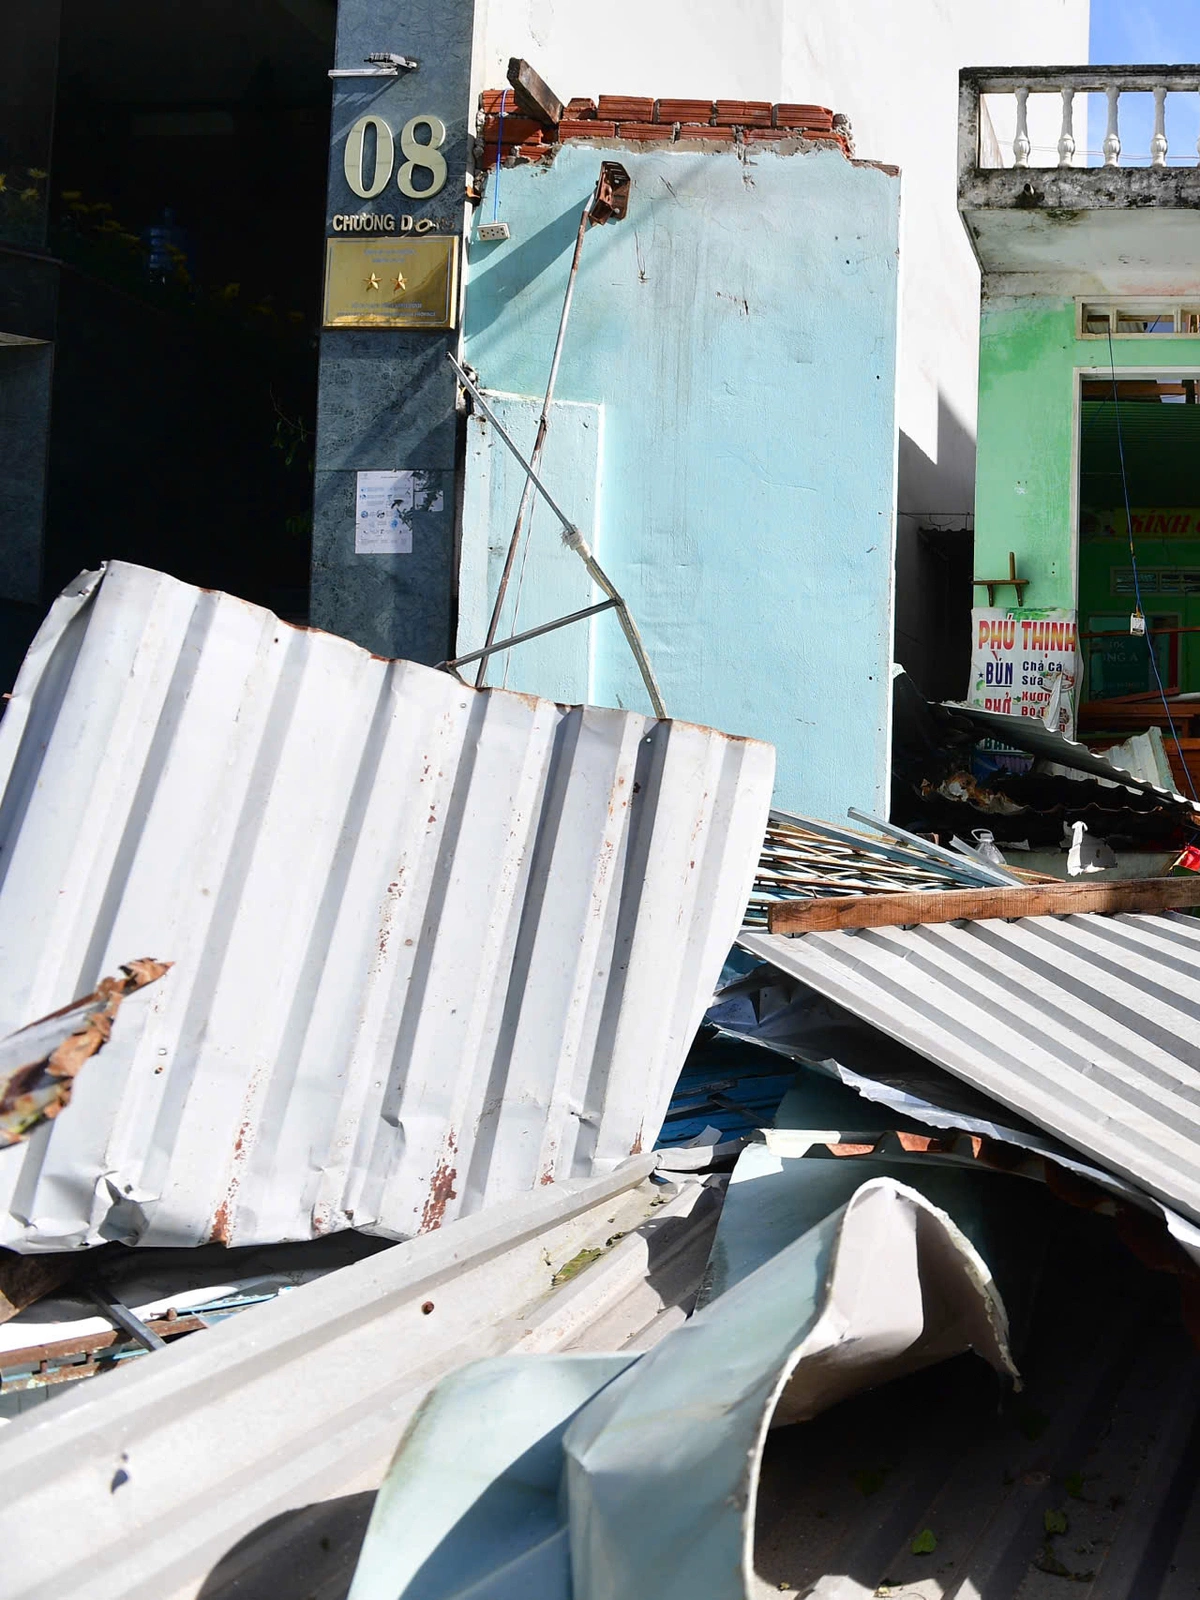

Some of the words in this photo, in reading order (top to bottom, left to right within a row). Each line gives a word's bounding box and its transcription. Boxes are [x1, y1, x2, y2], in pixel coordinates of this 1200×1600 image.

[343, 114, 448, 199] 08
[1126, 509, 1190, 535] KÍNH
[978, 614, 1016, 650] PHÚ
[1021, 621, 1077, 659] THỊNH
[985, 657, 1013, 685] BÚN
[1048, 661, 1063, 672] Cá
[1021, 691, 1051, 703] Xươn
